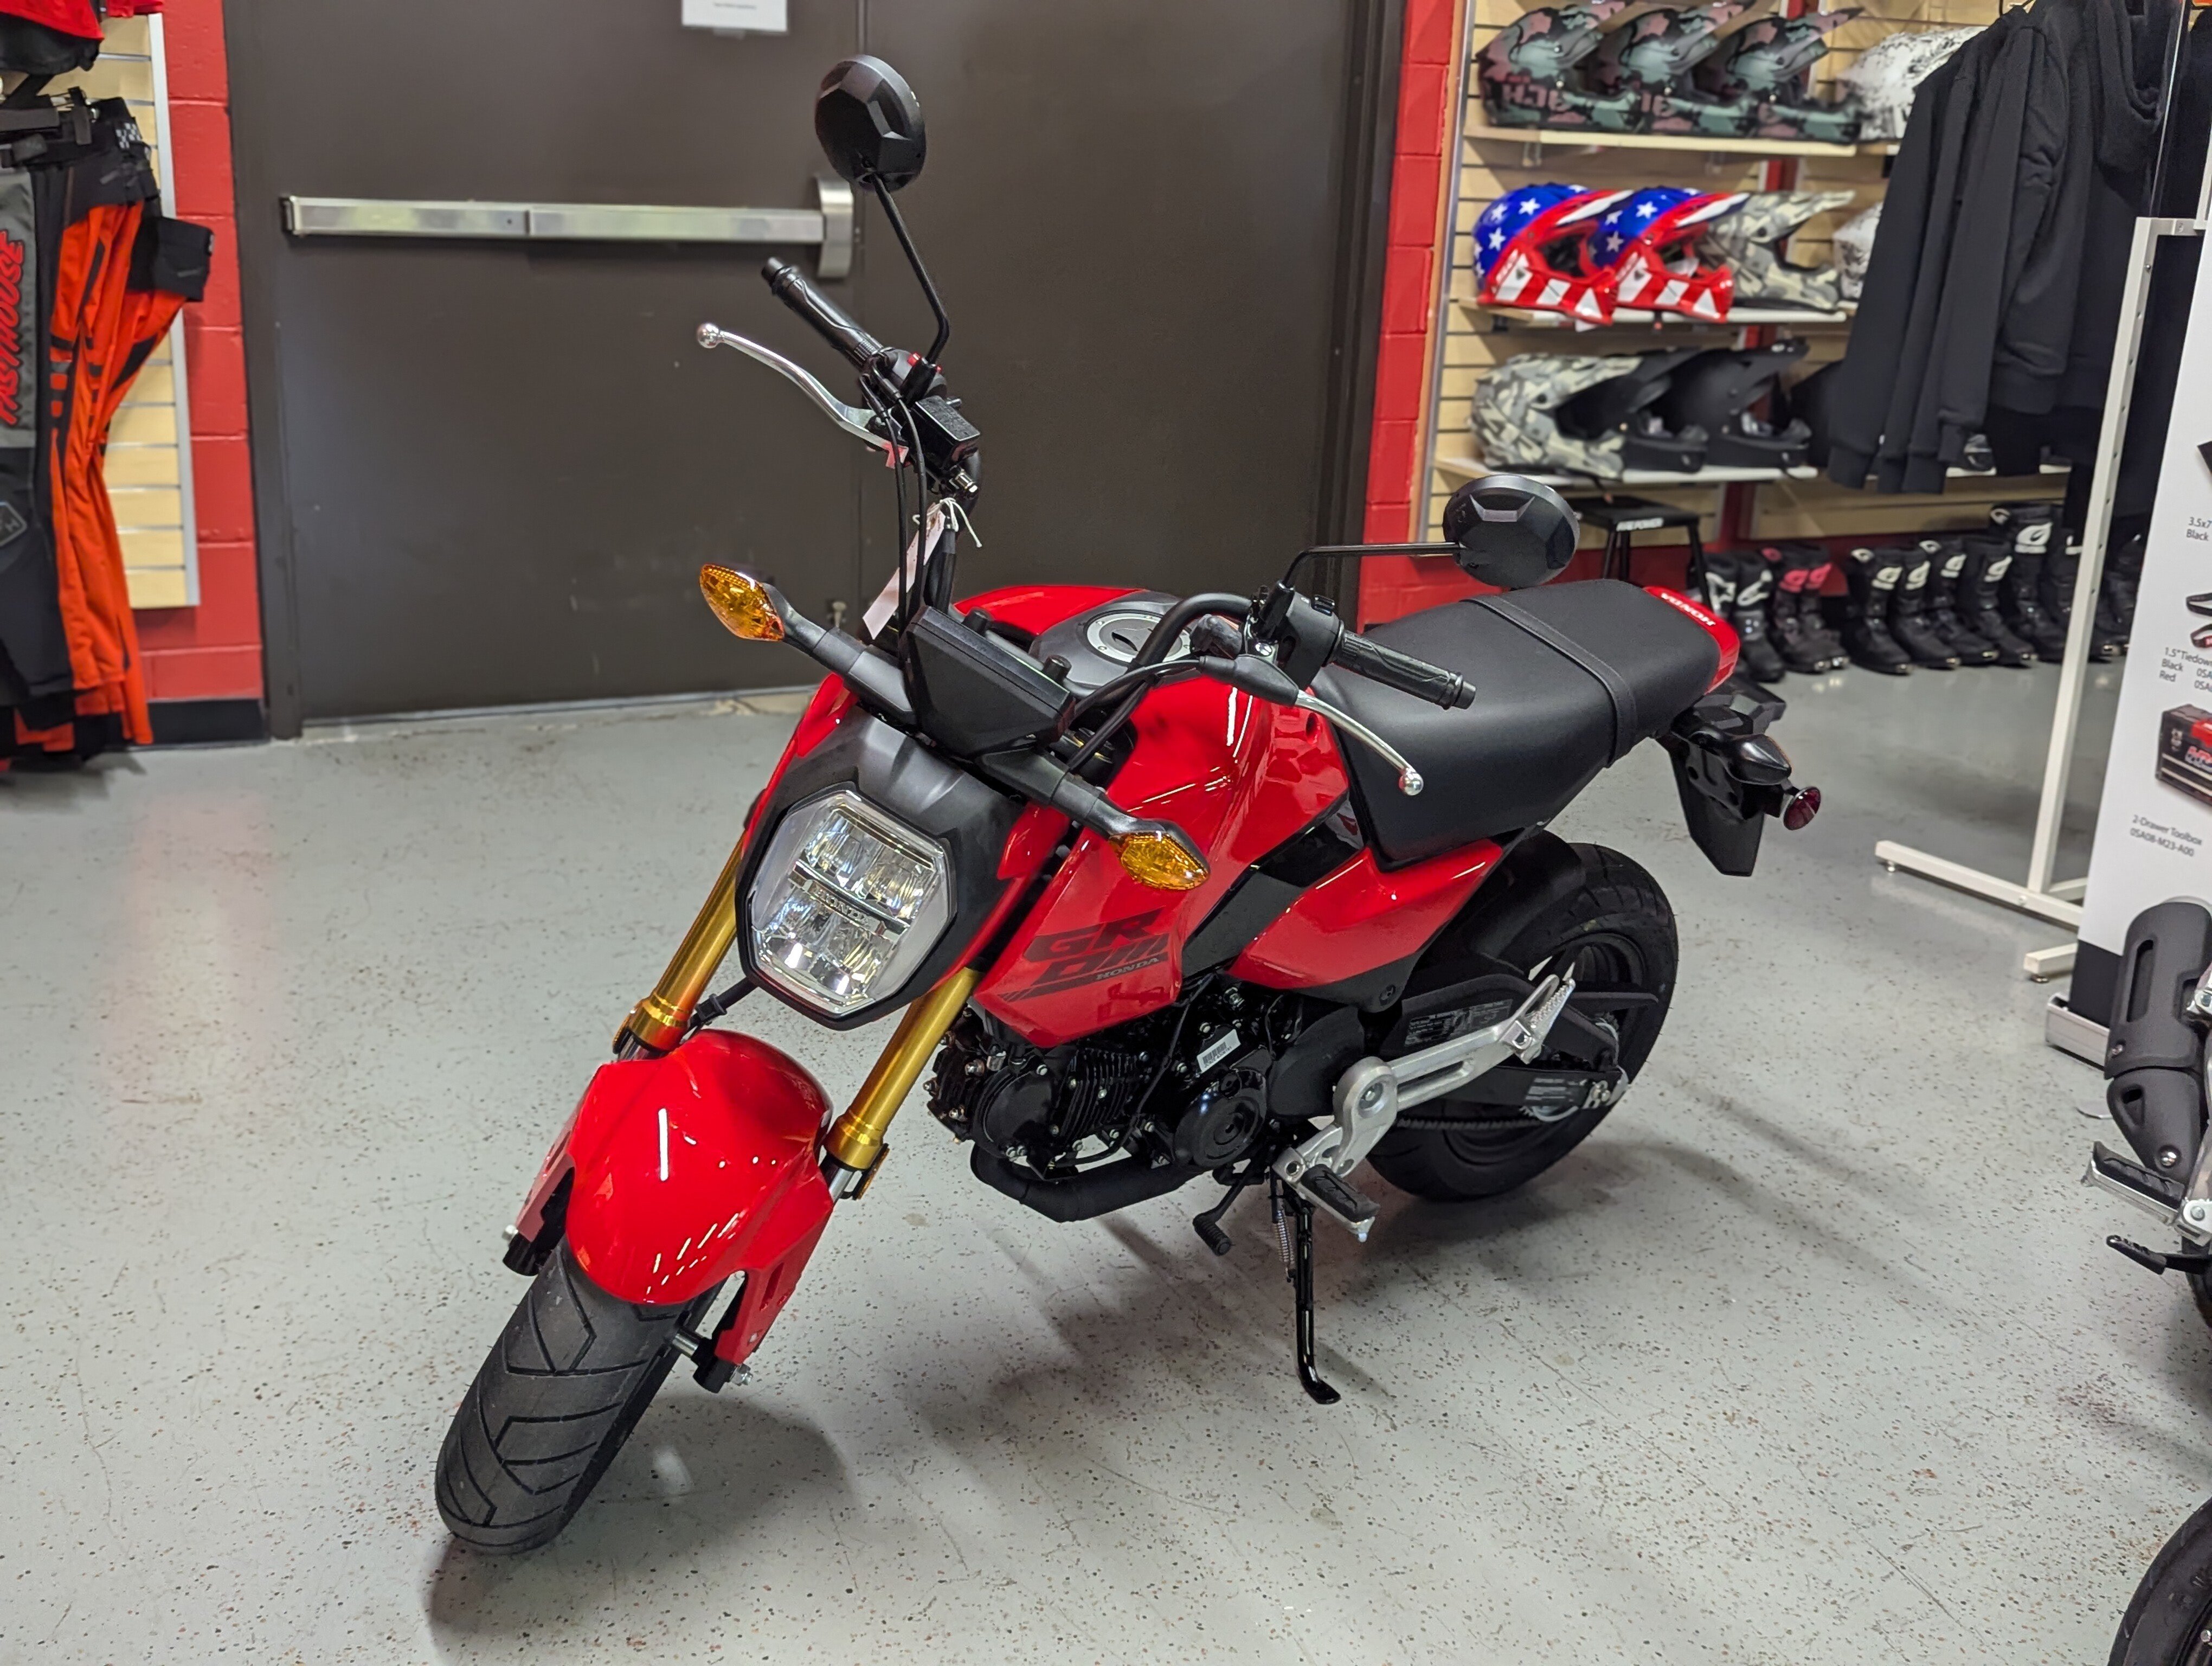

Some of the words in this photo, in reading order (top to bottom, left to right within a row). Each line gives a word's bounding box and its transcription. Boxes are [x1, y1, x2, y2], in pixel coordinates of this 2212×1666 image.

[2186, 529, 2209, 541] Black
[2162, 658, 2183, 672] Black
[2159, 670, 2176, 682] Red
[1096, 957, 1160, 981] HONDA
